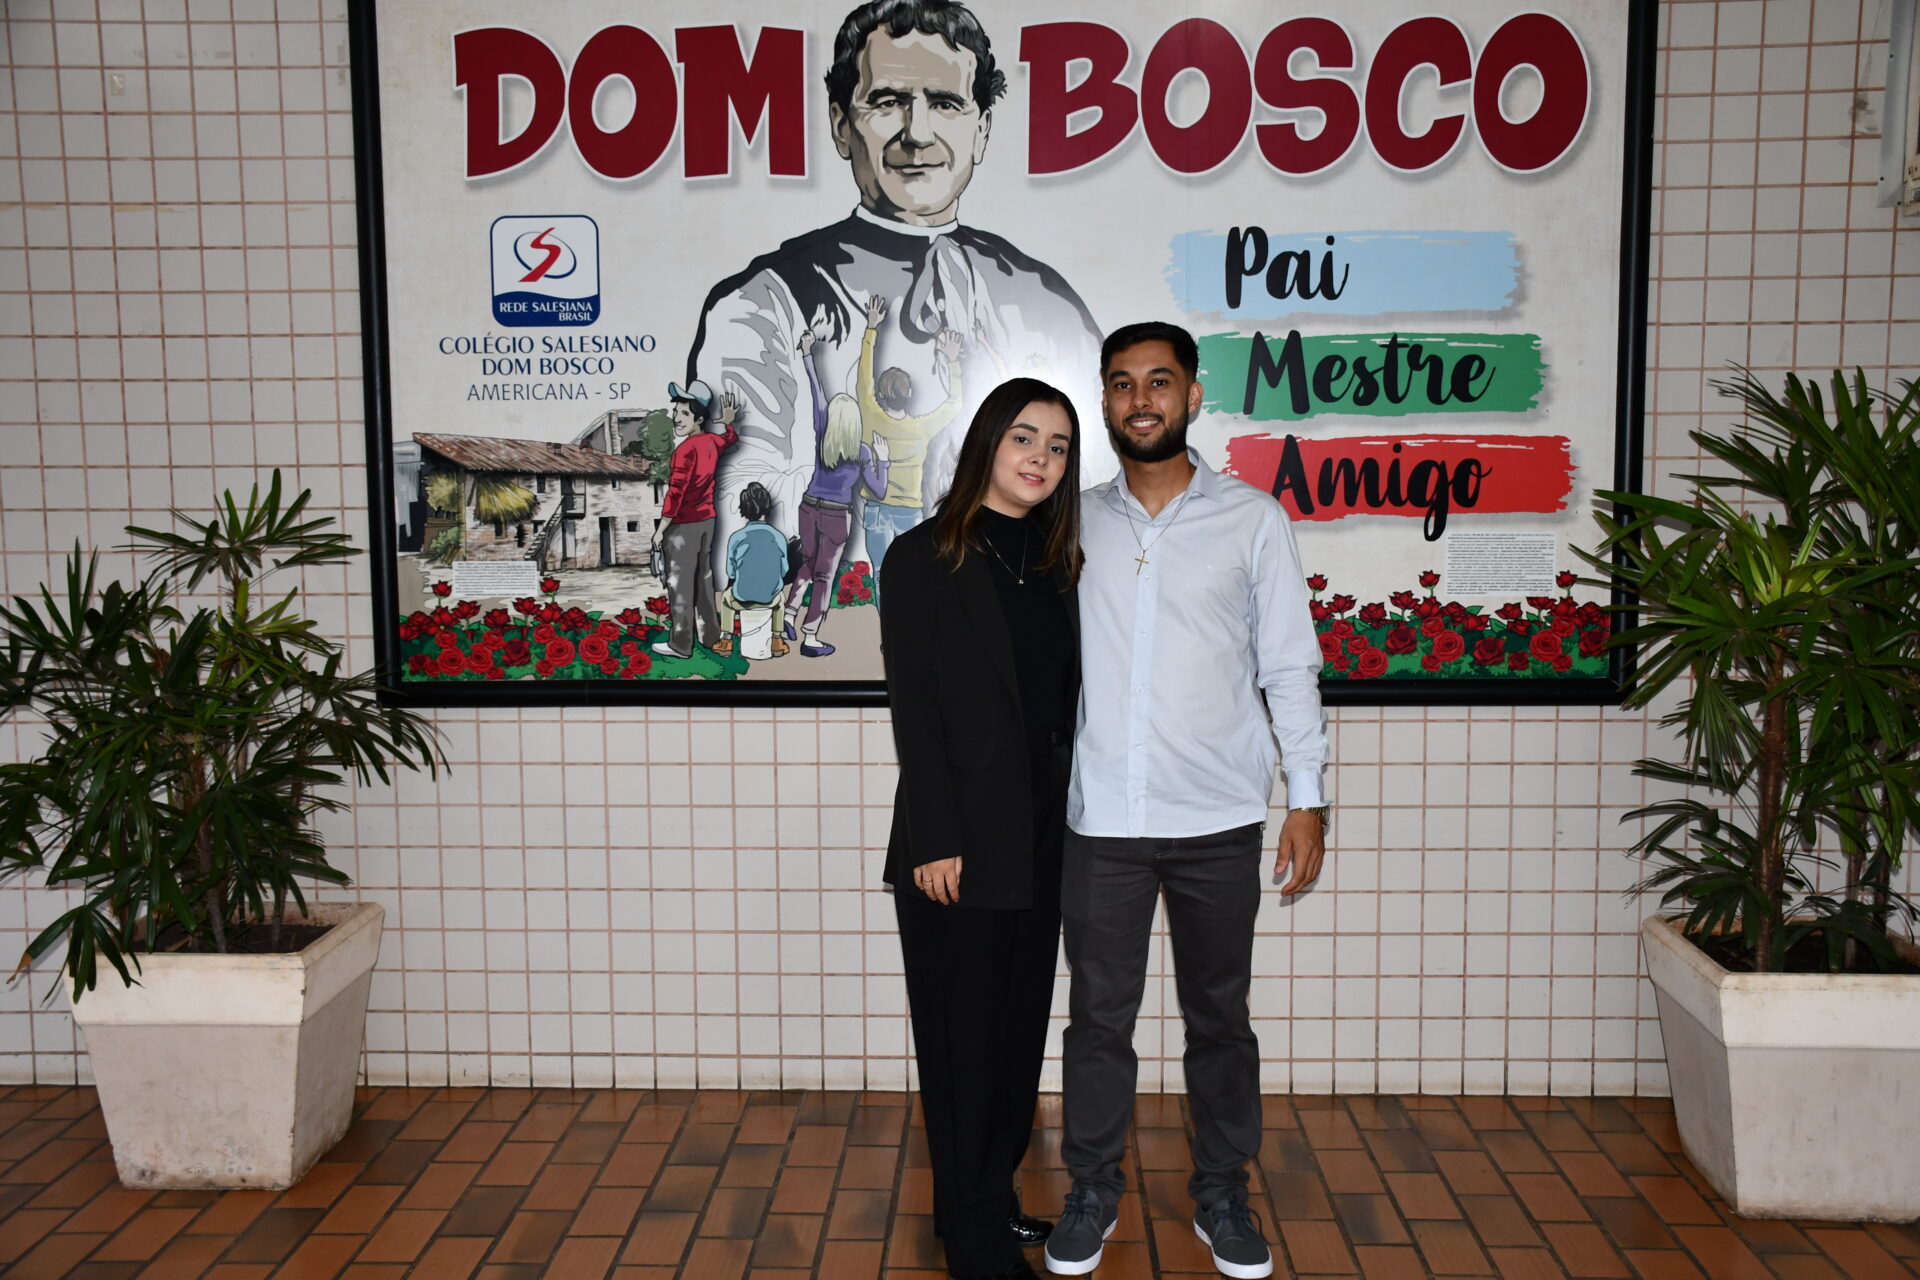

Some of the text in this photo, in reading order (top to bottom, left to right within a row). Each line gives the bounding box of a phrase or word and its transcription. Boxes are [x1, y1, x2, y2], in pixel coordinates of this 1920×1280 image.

[453, 11, 1591, 180] DOM BOSCO
[1224, 225, 1350, 309] Pai
[499, 301, 593, 313] REDE SALESIANA
[559, 313, 592, 321] BRASIL
[439, 332, 656, 355] COLÉGIO SALESIANO
[481, 356, 615, 376] DOM BOSCO
[1242, 329, 1496, 415] Mestre
[466, 383, 588, 401] AMERICANA
[609, 382, 631, 400] SP
[1271, 434, 1493, 542] Amigo
